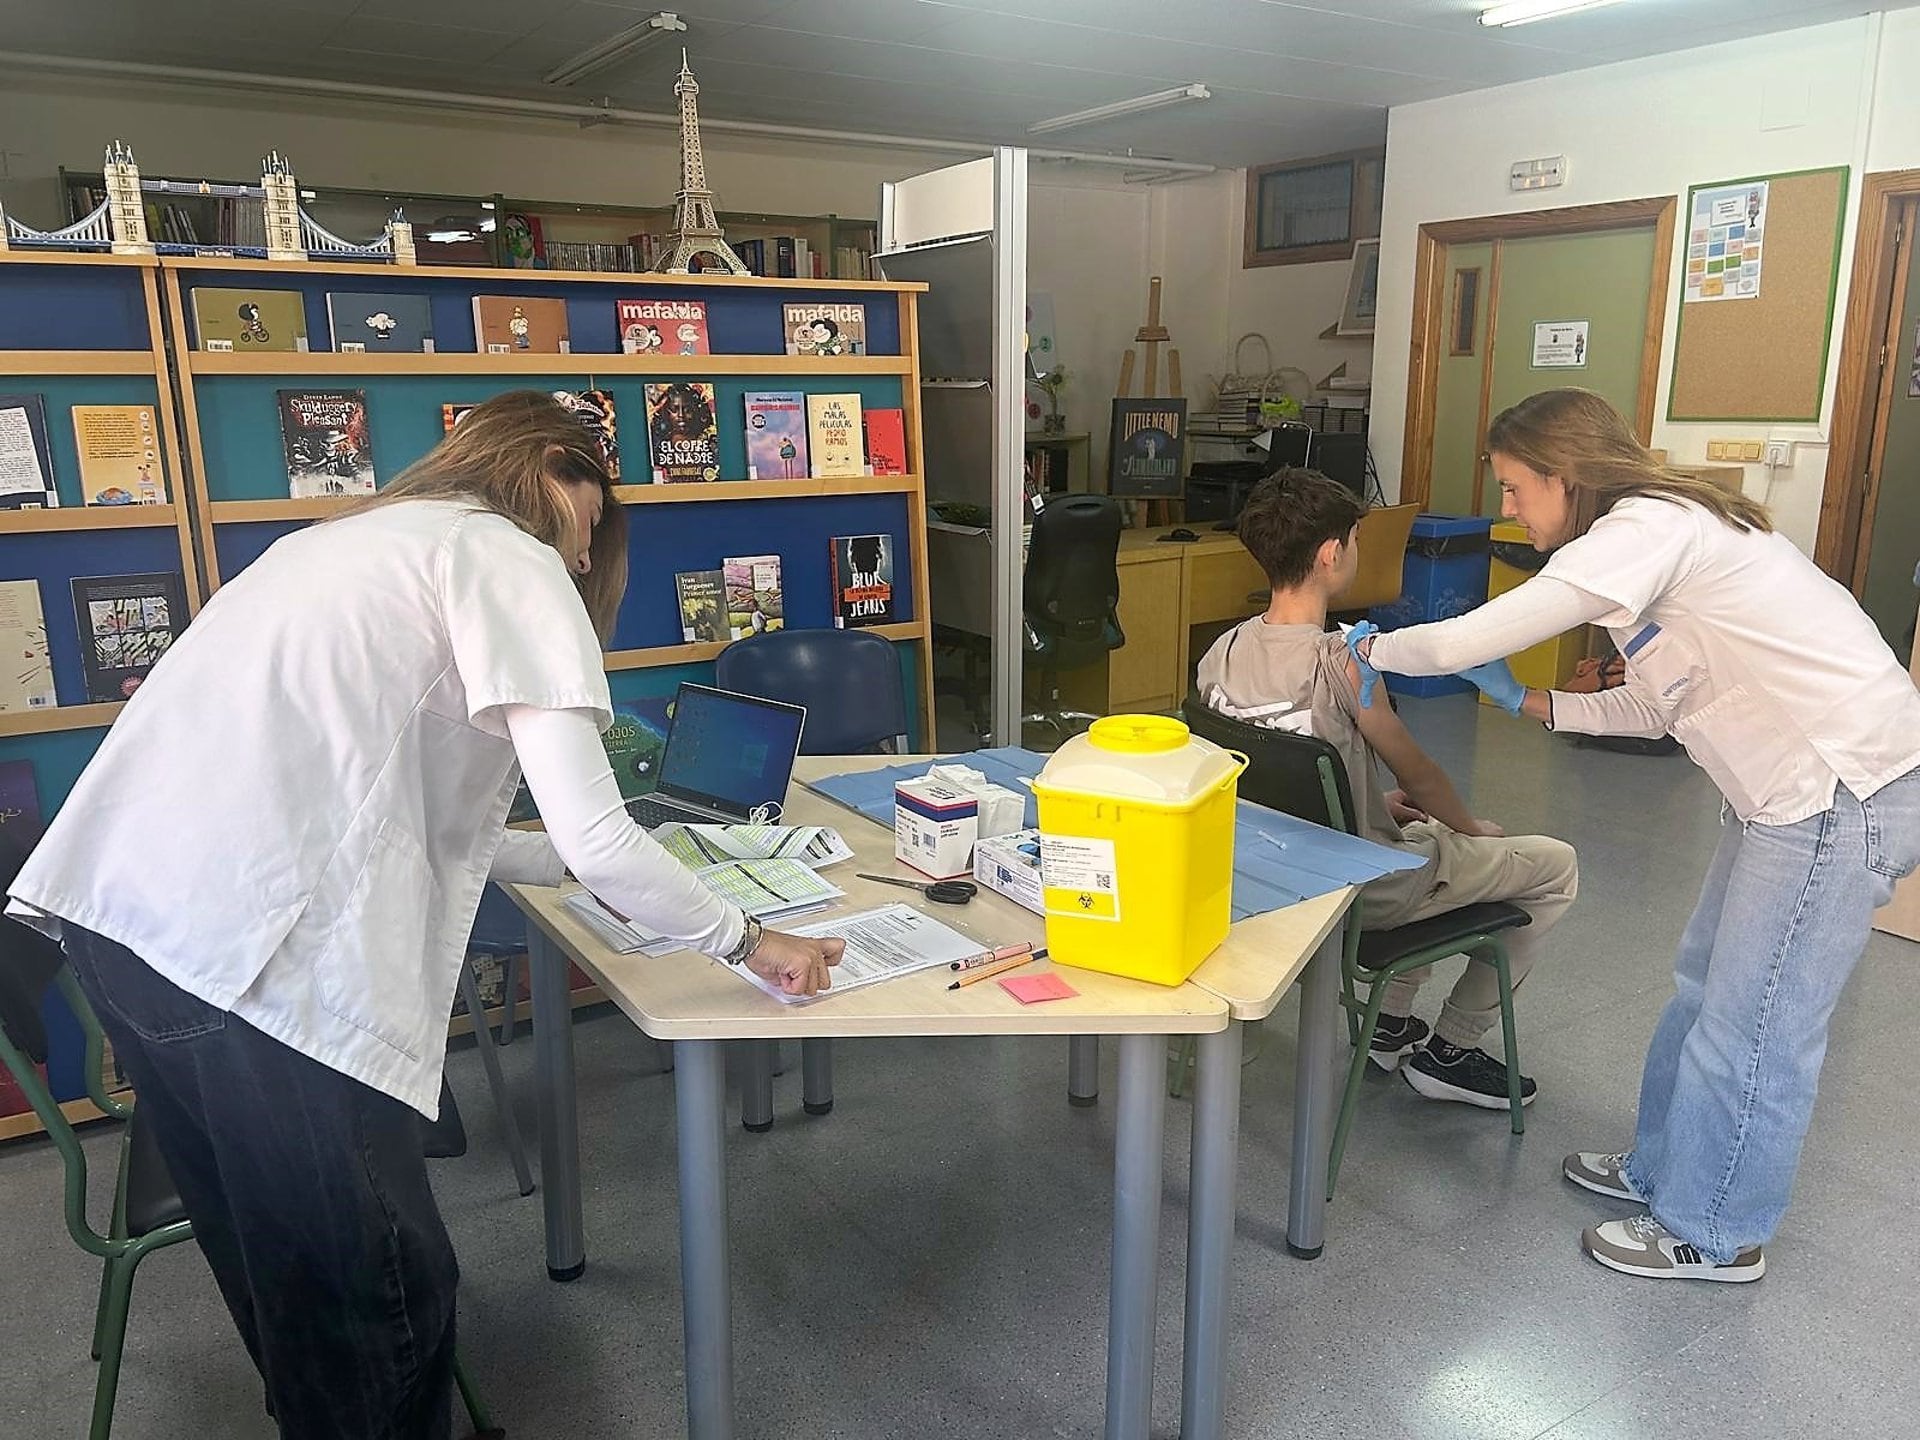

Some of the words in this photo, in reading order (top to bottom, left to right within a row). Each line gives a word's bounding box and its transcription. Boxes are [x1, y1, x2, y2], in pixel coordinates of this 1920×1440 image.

[622, 302, 703, 319] mafalda
[788, 305, 862, 322] mafalda
[291, 399, 357, 415] Skulduggery
[302, 412, 348, 426] Pleasant
[1124, 412, 1151, 442] LITTLE
[660, 440, 674, 453] EL
[675, 440, 710, 452] COFRE
[659, 453, 673, 465] DE
[674, 452, 714, 465] NADIE
[850, 598, 886, 617] JEANS
[607, 725, 636, 740] OJOS
